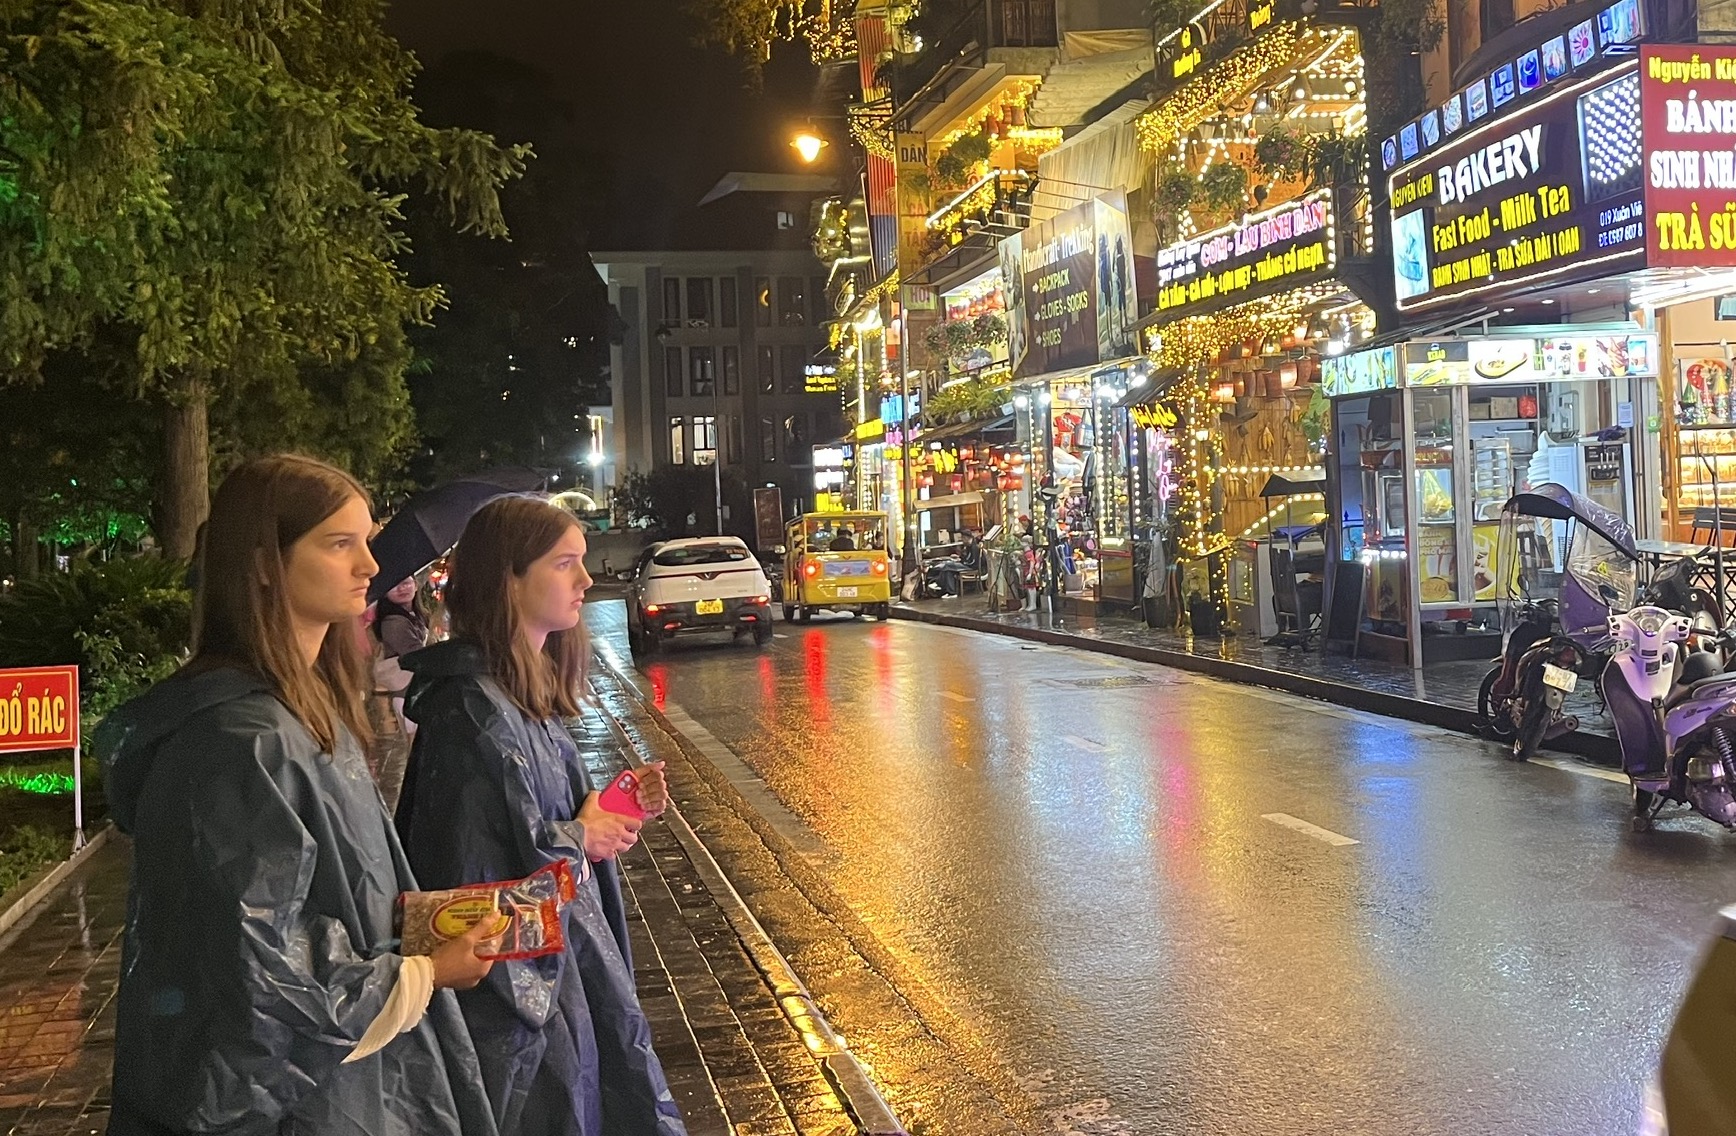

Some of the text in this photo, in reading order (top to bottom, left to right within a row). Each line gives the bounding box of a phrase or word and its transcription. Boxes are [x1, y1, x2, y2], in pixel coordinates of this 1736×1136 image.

[1666, 89, 1736, 133] BÁNH
[1438, 124, 1542, 205] BAKERY
[1650, 143, 1736, 188] SINH NH
[1432, 220, 1458, 253] Fast
[1458, 206, 1491, 245] Food
[1500, 192, 1537, 232] Milk
[1538, 185, 1570, 218] Tea
[1656, 201, 1705, 249] TRÀ
[27, 687, 65, 734] RÁC
